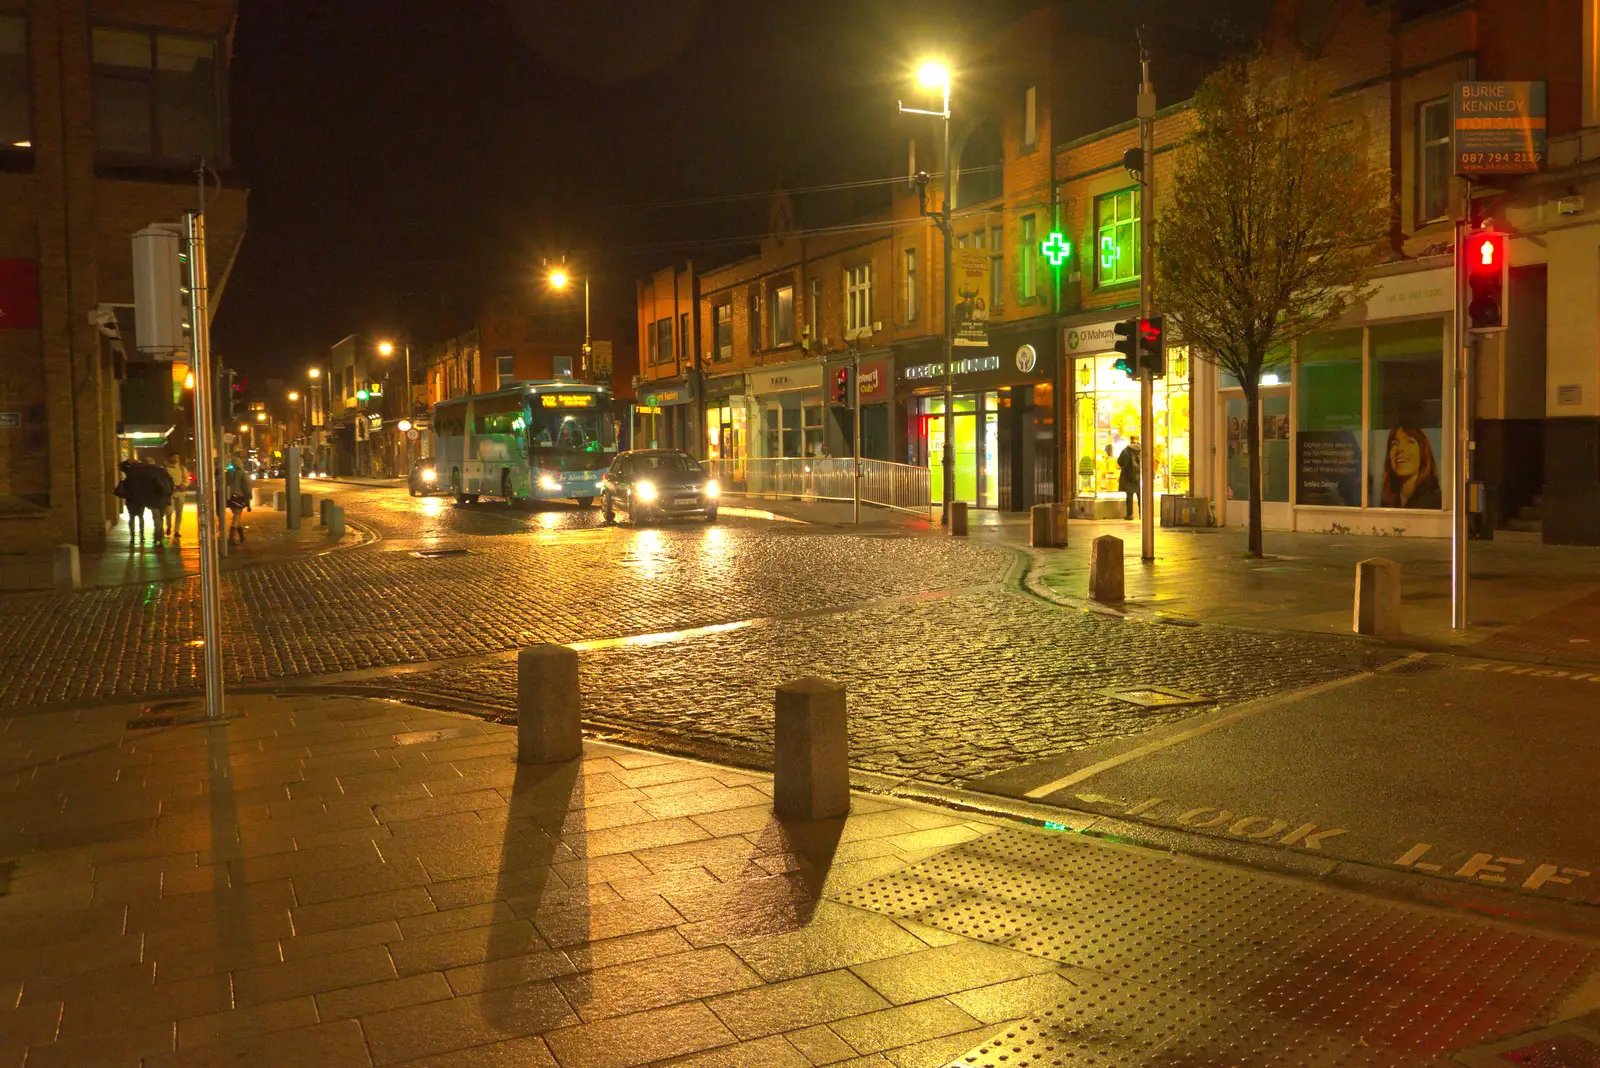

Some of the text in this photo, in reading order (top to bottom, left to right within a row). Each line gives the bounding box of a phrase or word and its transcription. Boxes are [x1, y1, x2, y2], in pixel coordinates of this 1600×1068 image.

[1461, 86, 1505, 98] BURKE
[1461, 100, 1524, 112] KENNEDY
[1461, 153, 1483, 163] 087
[1488, 152, 1509, 162] 794
[931, 361, 964, 377] CRDIT
[966, 356, 999, 372] UNION
[541, 395, 557, 407] 702
[1125, 798, 1350, 850] LOOK
